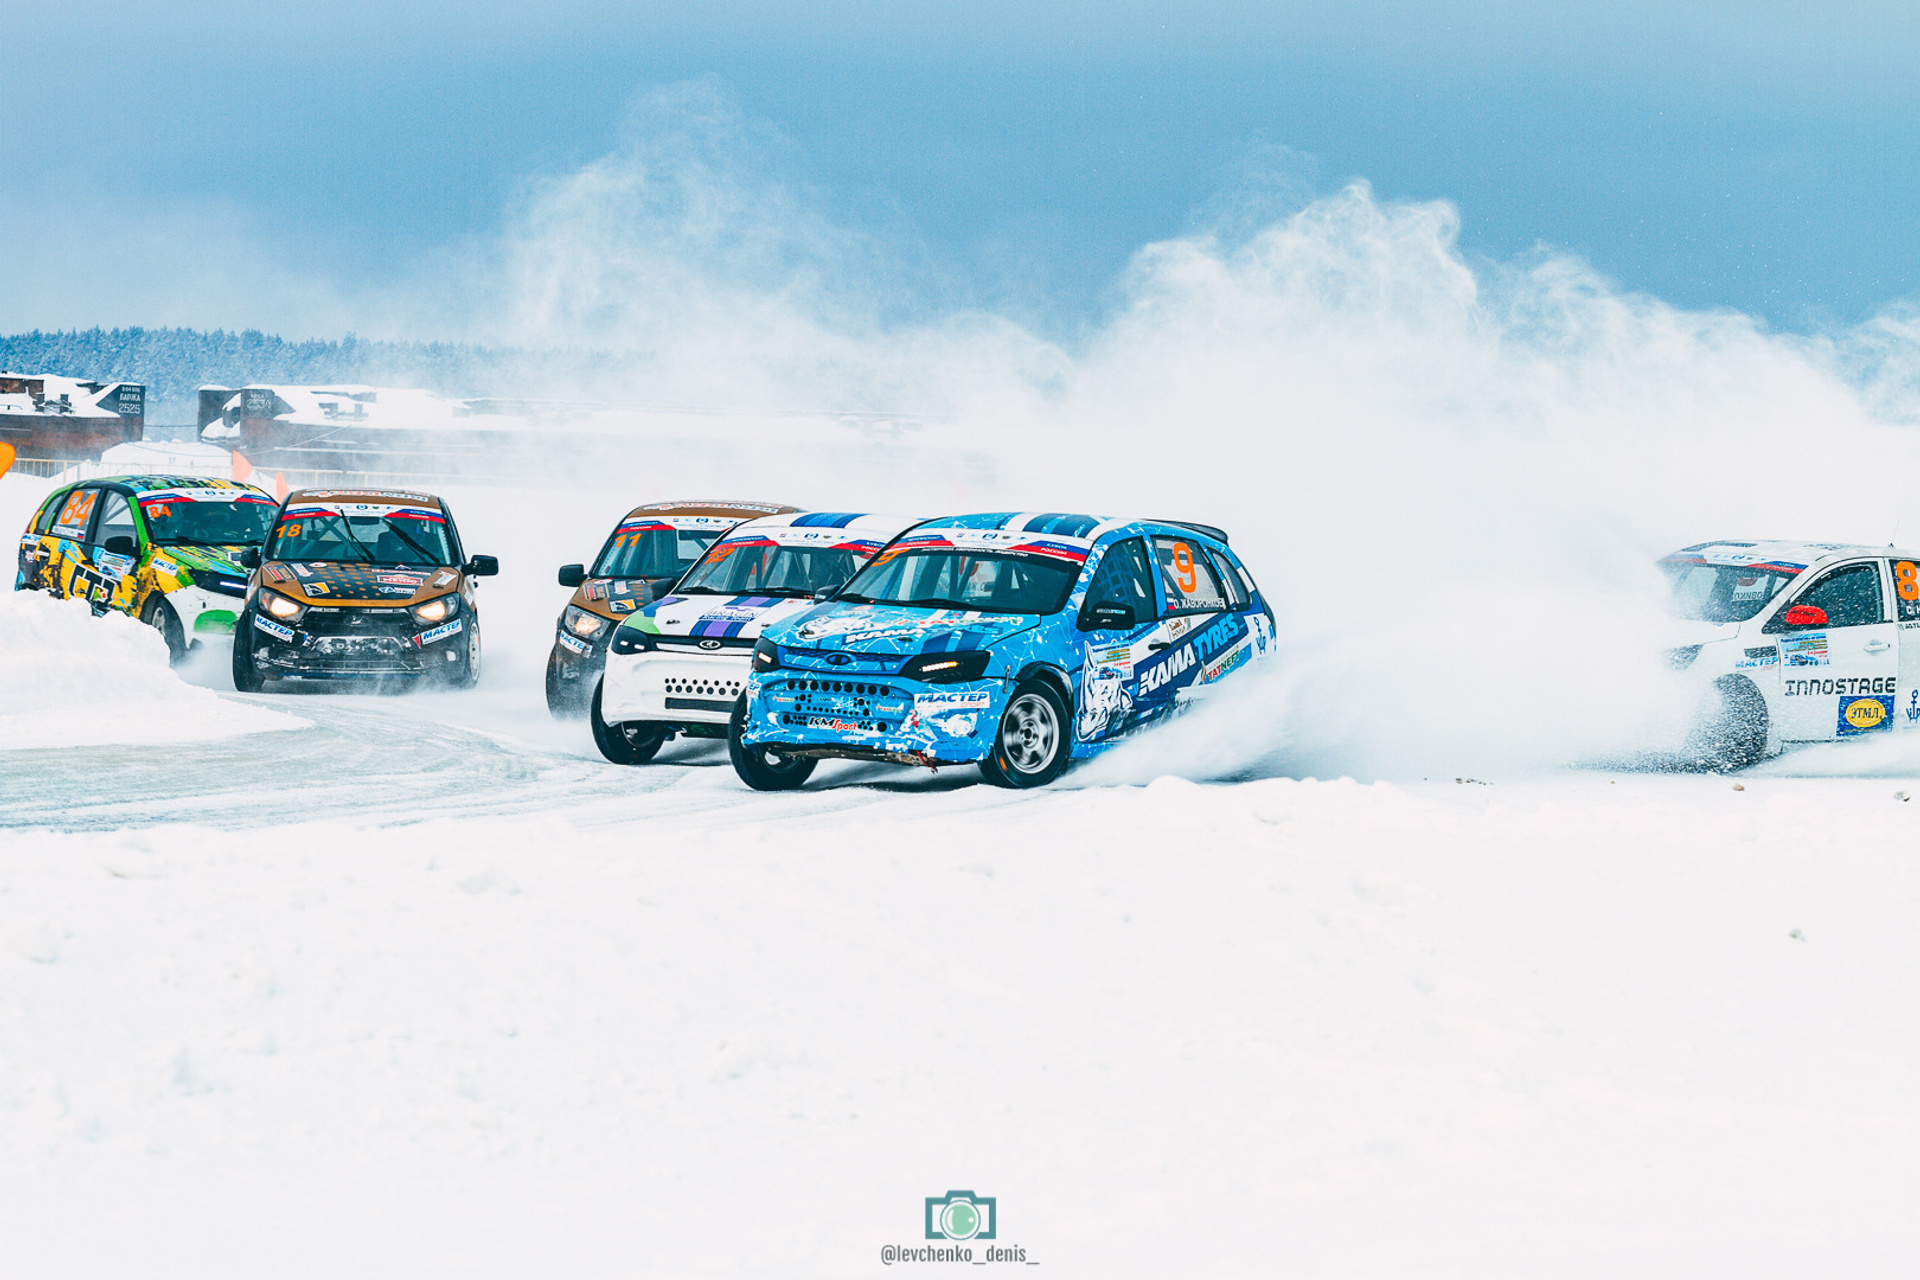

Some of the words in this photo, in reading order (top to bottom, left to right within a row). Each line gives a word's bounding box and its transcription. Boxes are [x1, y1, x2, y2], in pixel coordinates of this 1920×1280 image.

[118, 403, 141, 414] 2525
[60, 491, 97, 527] 84
[148, 505, 172, 518] 84
[276, 524, 302, 539] 18
[615, 533, 642, 548] 11
[703, 547, 735, 565] 12
[871, 548, 911, 568] 9
[1173, 542, 1197, 593] 9
[256, 616, 293, 636] МАСТЕР
[423, 620, 461, 640] МАСТЕР
[845, 628, 926, 644] KAMA
[1139, 643, 1197, 696] KAMA
[1193, 612, 1240, 662] TYRES
[1208, 650, 1239, 681] TATNEFT
[917, 692, 988, 704] МАСТЕР
